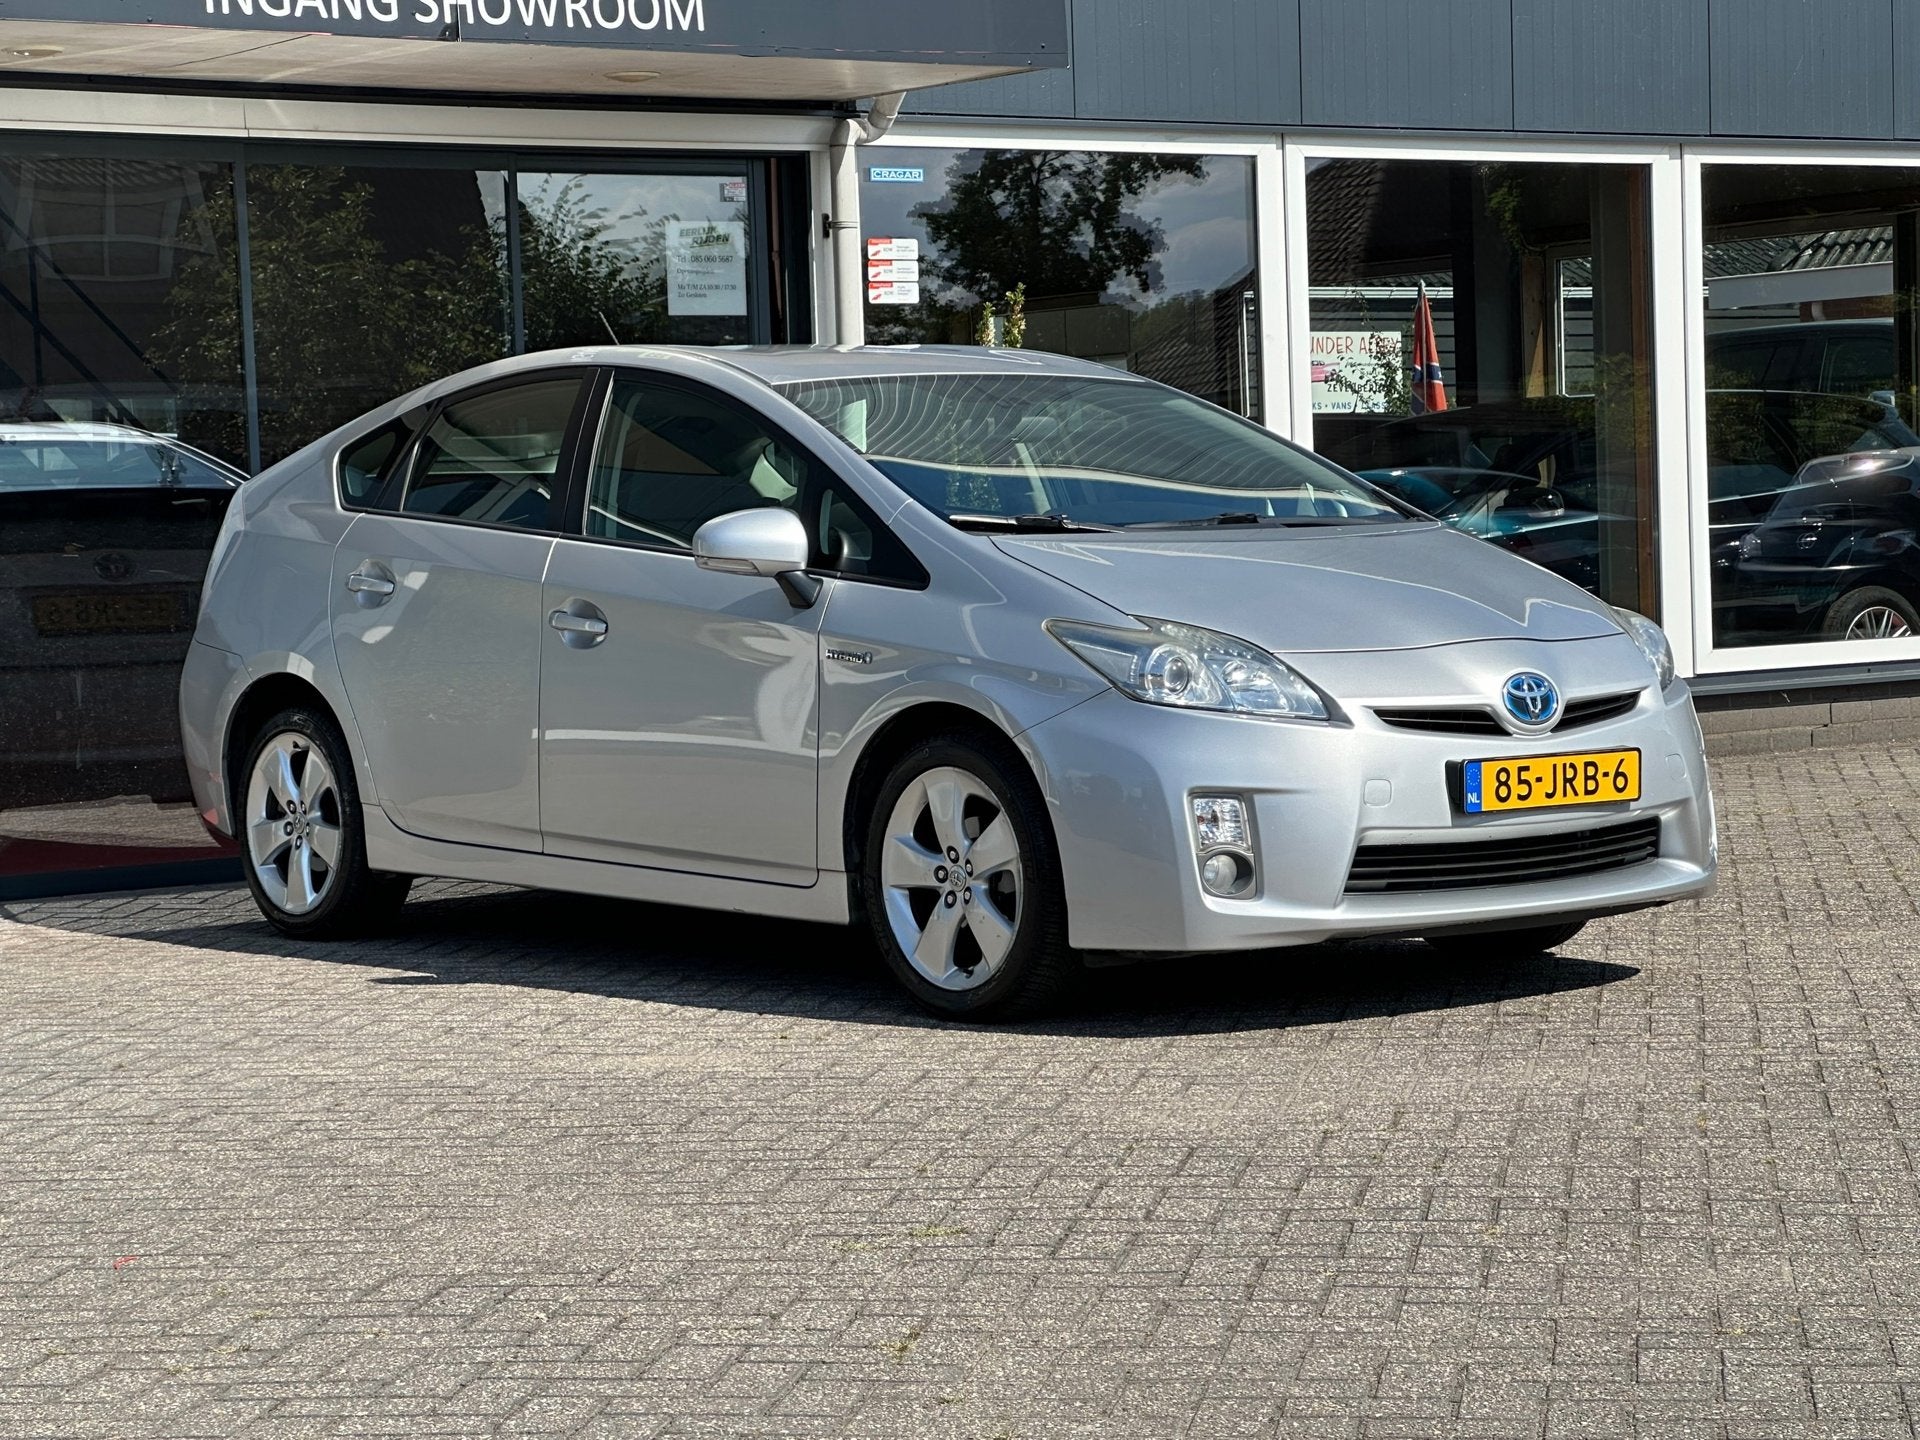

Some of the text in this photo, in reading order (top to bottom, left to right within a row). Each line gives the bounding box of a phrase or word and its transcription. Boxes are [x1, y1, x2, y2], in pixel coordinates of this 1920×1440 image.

[414, 0, 705, 31] SHOWROOM
[873, 170, 920, 179] CRAGAR
[691, 233, 730, 246] RIJDEN
[1331, 402, 1352, 410] VANS
[1494, 758, 1629, 803] 85-JRB-6
[1467, 792, 1480, 803] NL
